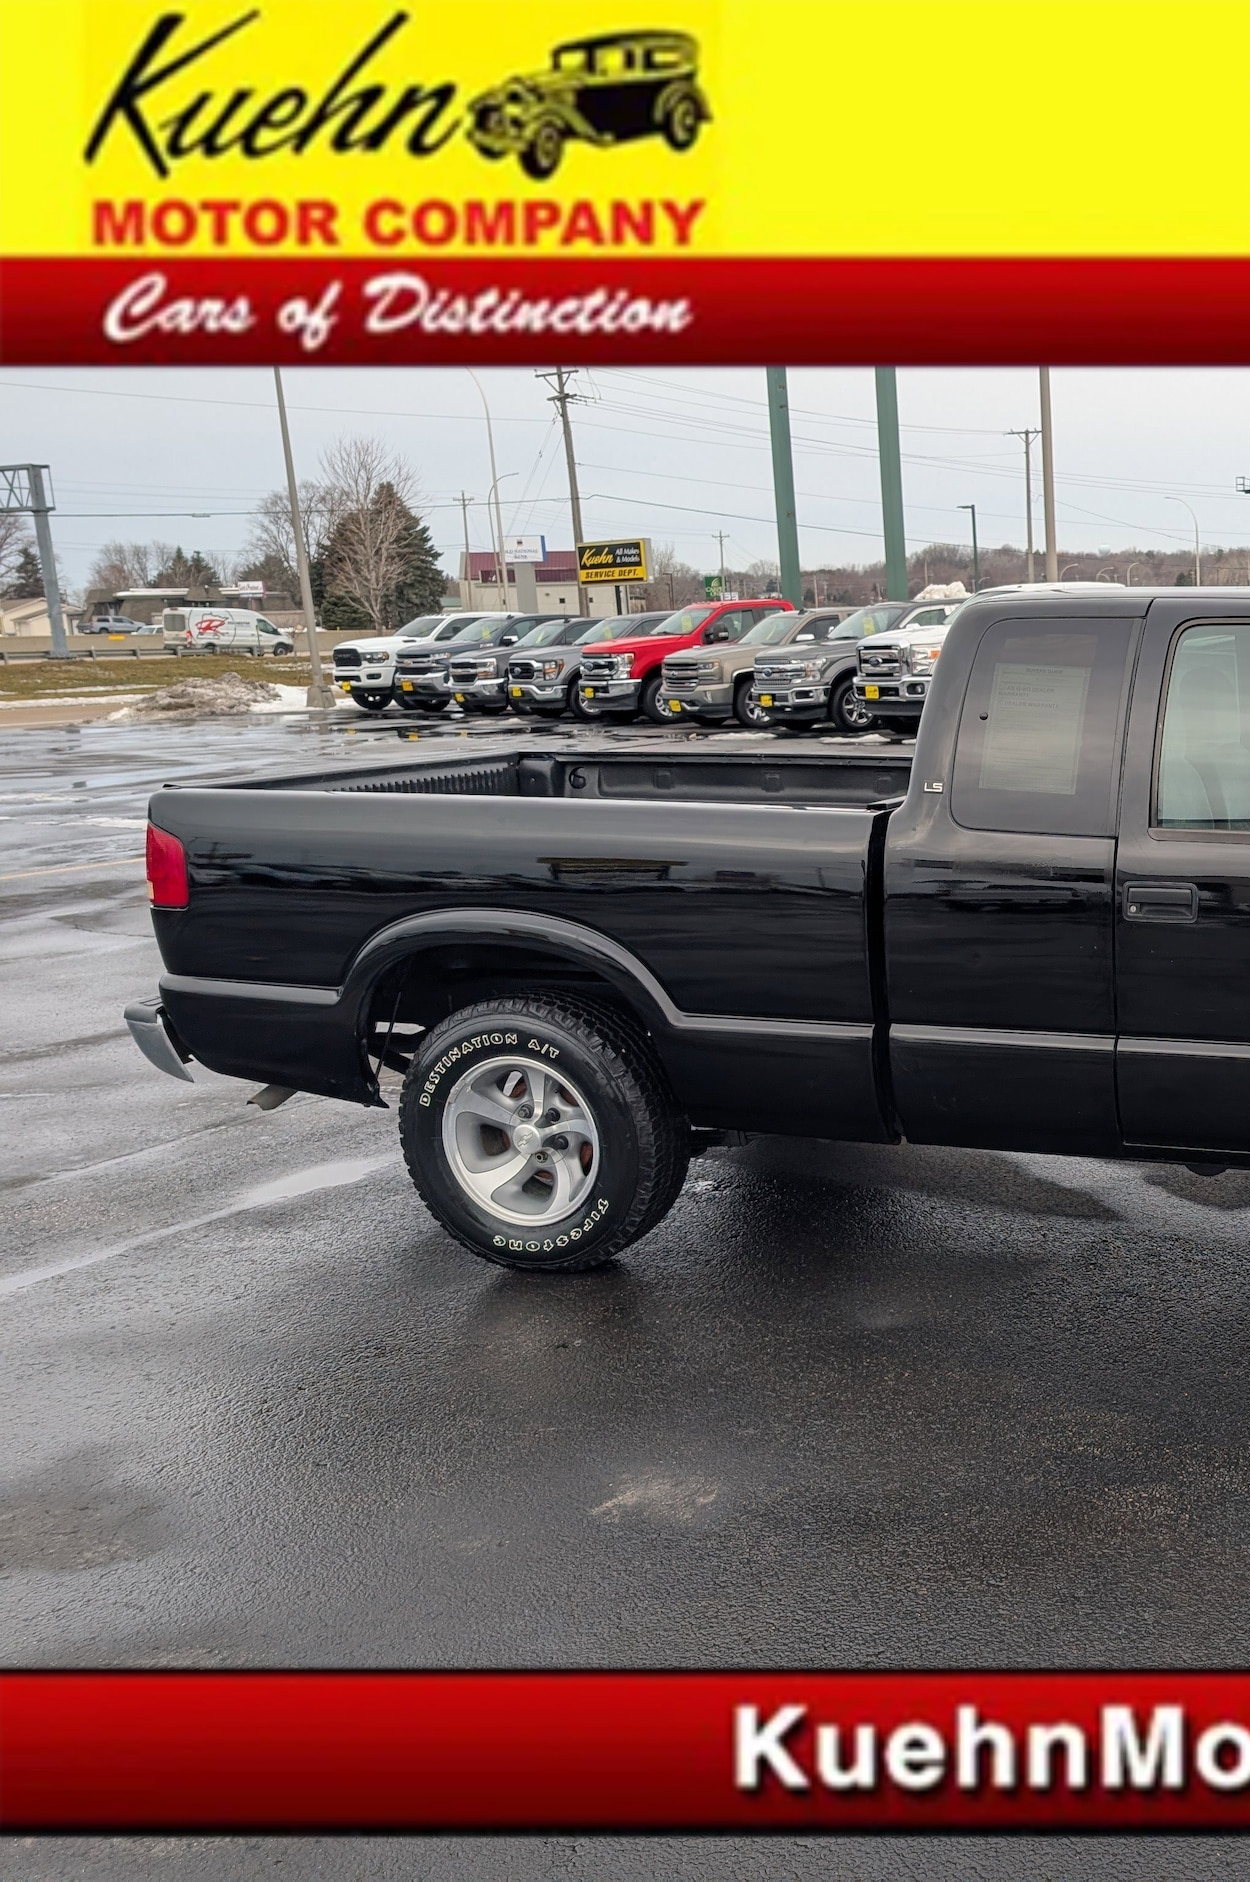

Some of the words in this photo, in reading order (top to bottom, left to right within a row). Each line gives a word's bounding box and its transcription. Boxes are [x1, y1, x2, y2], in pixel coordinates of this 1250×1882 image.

[581, 547, 614, 567] Kuehn
[621, 554, 640, 563] Models
[585, 570, 615, 579] SERVICE
[618, 569, 639, 577] DEPT.
[924, 782, 943, 792] LS
[419, 1032, 518, 1107] DESTINATION
[528, 1039, 560, 1059] A/T
